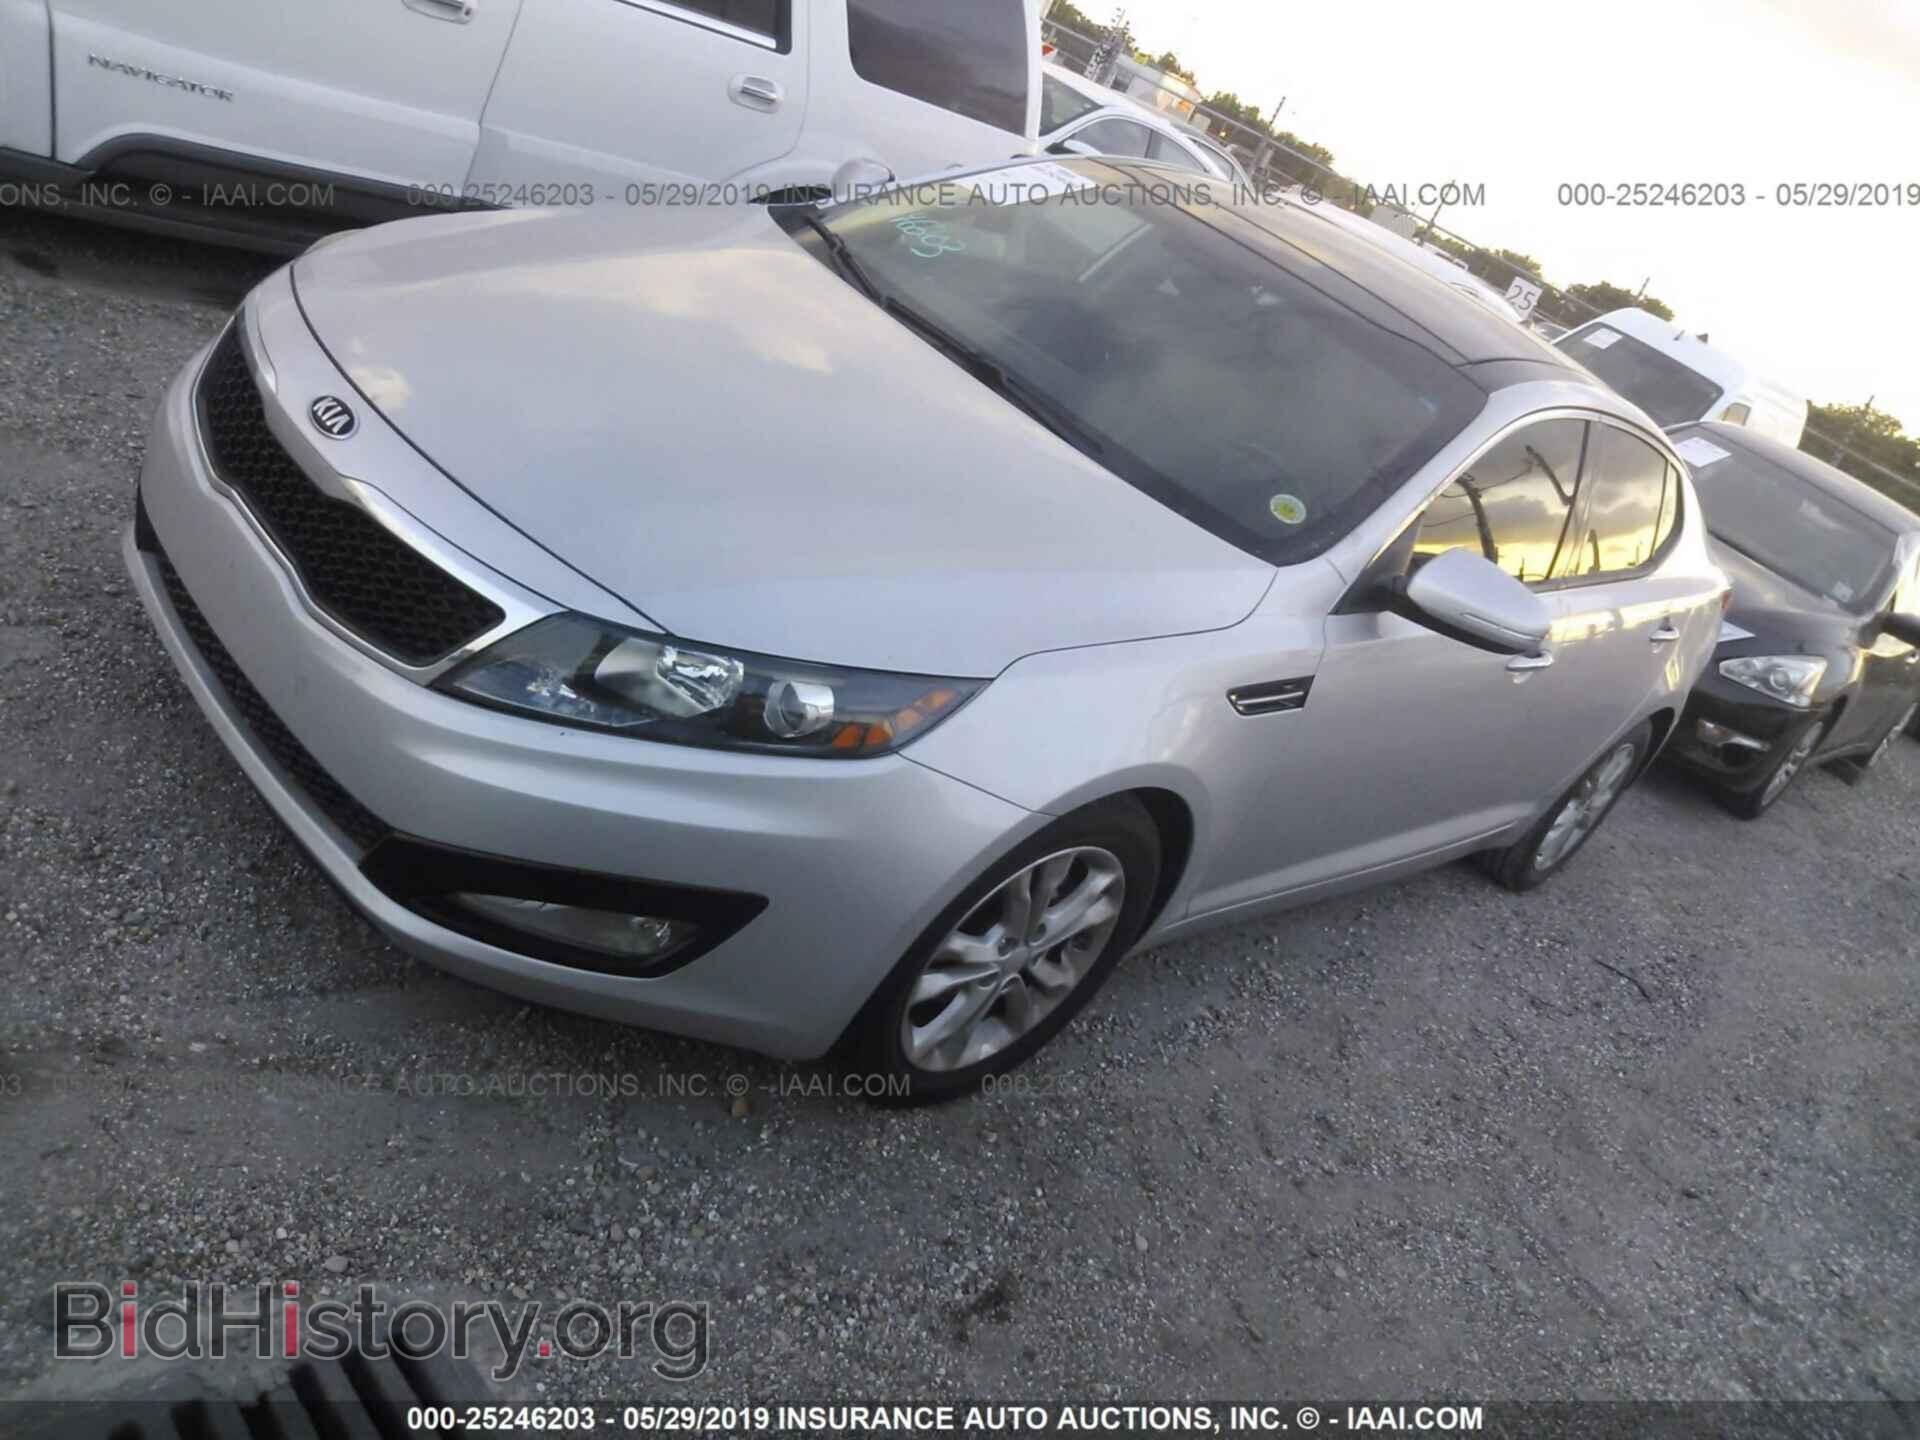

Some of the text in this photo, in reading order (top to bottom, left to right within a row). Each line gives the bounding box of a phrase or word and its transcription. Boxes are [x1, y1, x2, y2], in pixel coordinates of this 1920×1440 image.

[87, 52, 233, 102] NAVIGATOR
[1505, 284, 1537, 310] 25
[313, 397, 350, 434] KIA
